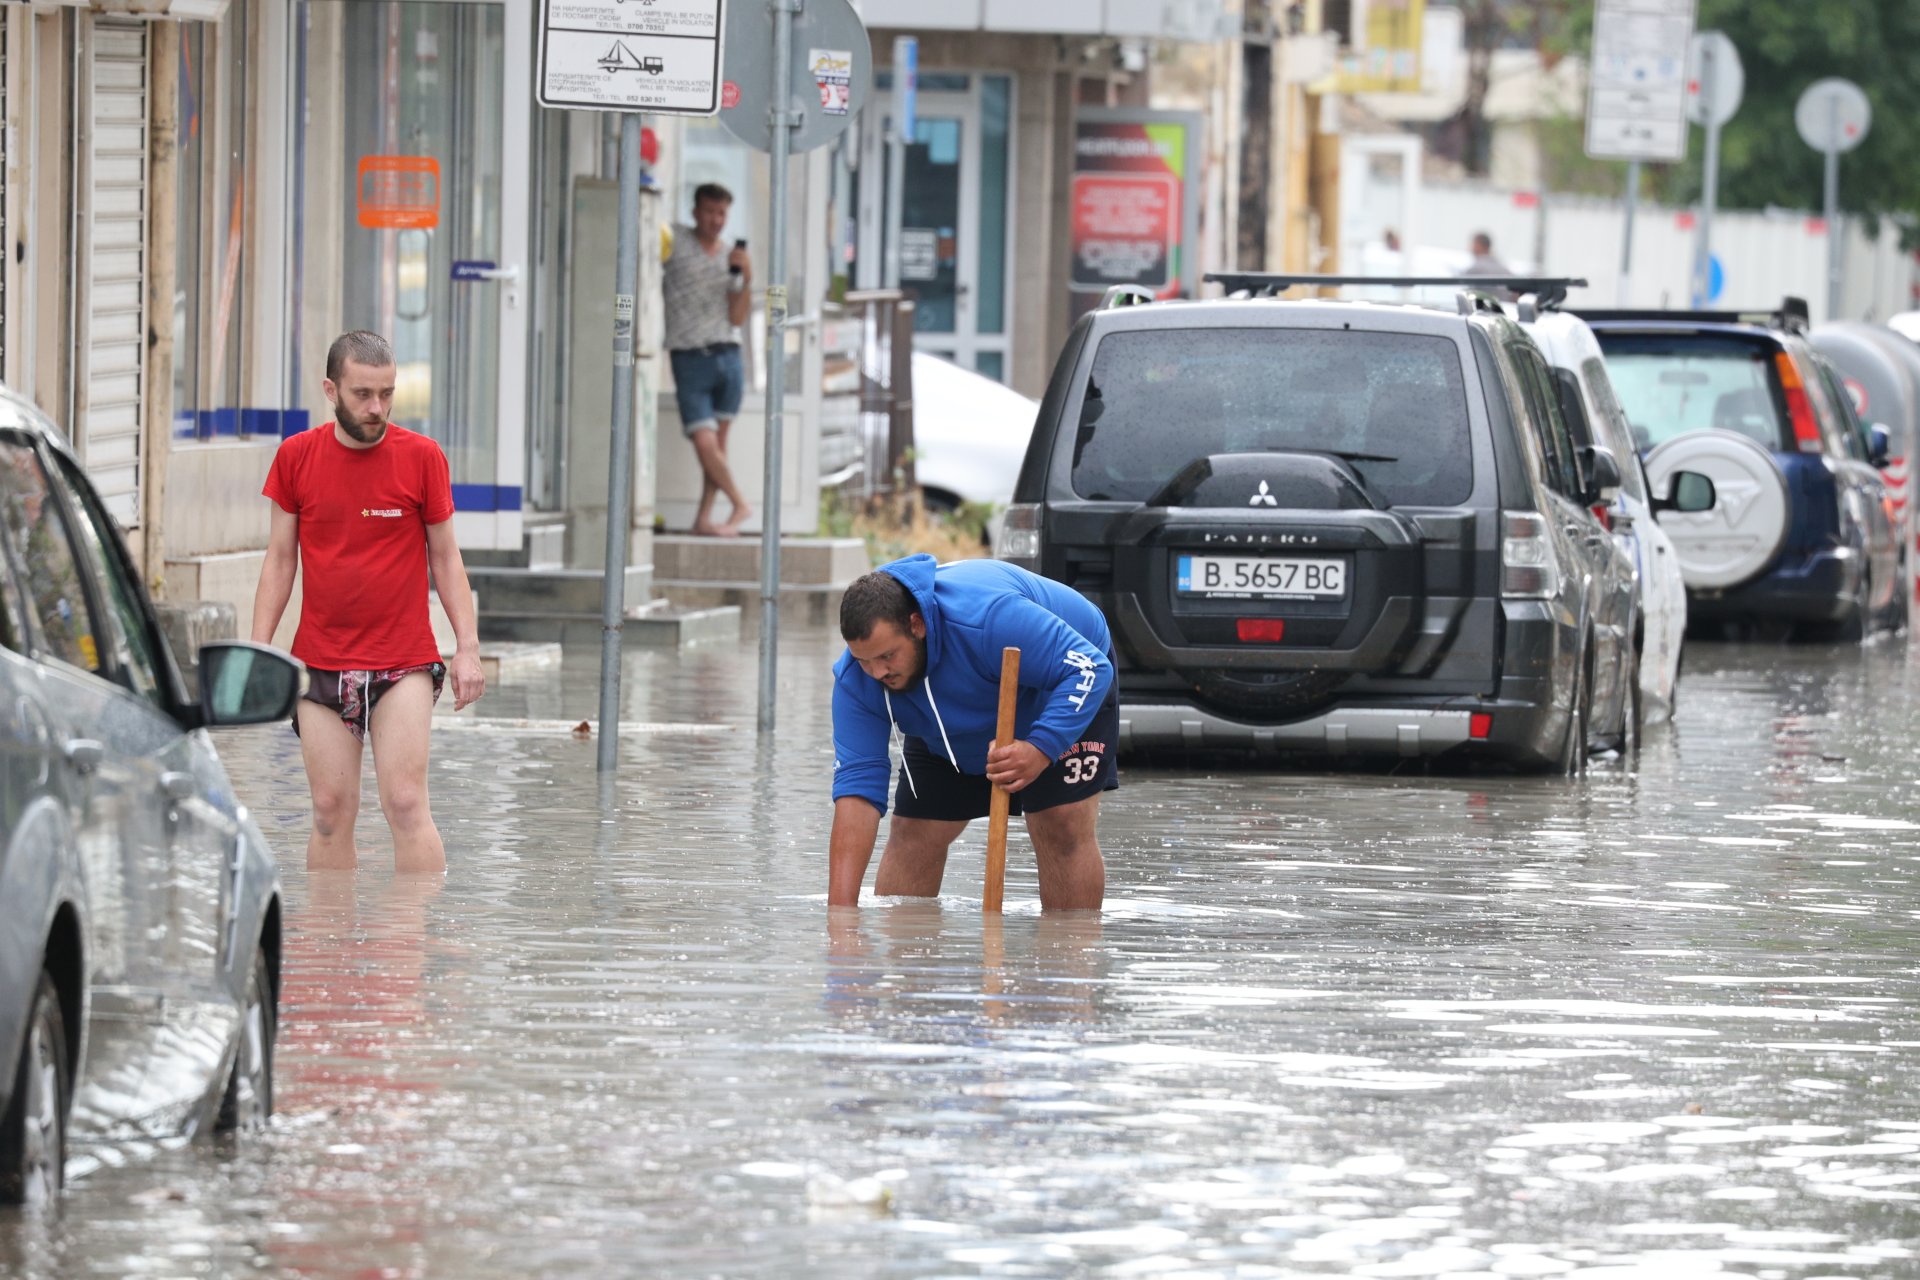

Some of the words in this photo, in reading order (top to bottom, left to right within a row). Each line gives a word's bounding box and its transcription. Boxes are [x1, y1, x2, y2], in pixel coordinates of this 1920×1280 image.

[635, 10, 661, 18] CLAMPS
[642, 17, 670, 25] VEHICLE
[1081, 741, 1106, 755] YORK
[1063, 755, 1100, 784] 33
